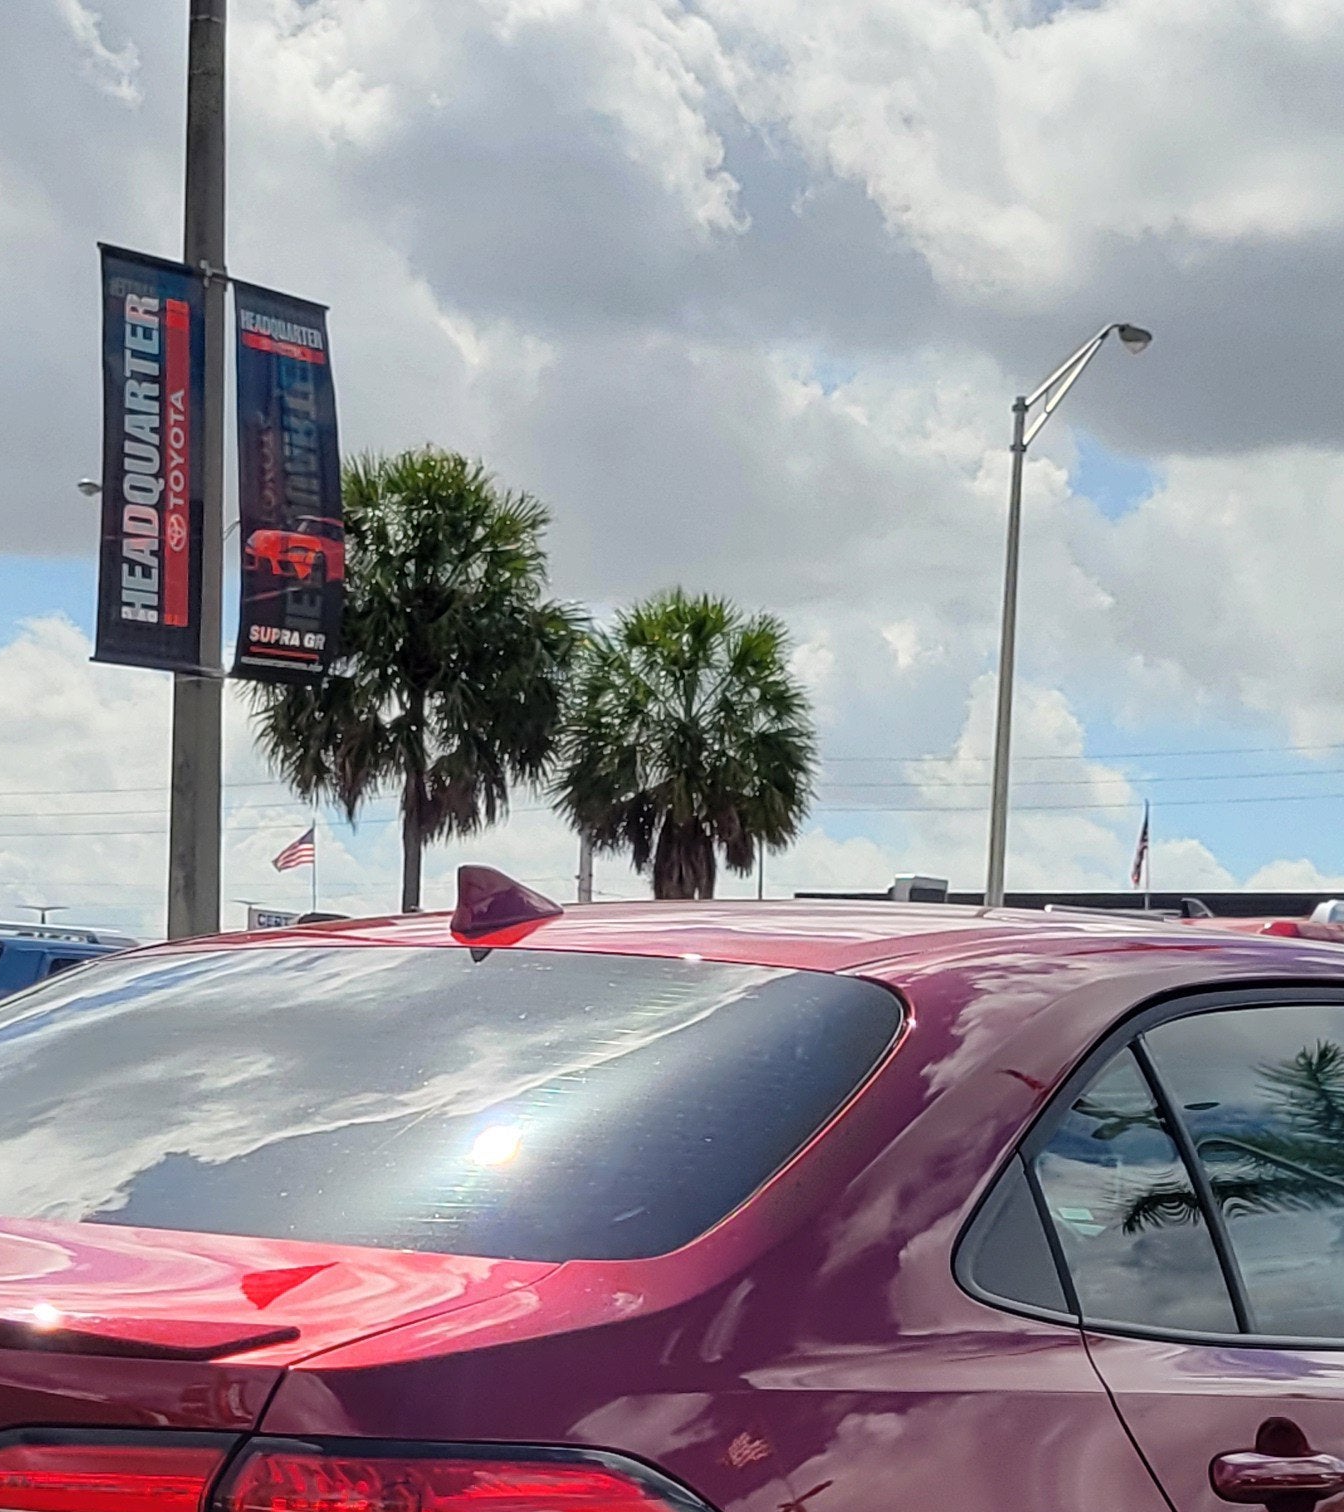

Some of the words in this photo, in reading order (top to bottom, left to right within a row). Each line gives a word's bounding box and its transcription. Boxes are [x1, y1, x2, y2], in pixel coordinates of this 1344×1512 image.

[240, 308, 324, 350] HEADQUARTER
[121, 293, 165, 624] HEADQUARTER
[168, 388, 186, 510] TOYOTA
[249, 624, 301, 647] SUPRA
[303, 632, 326, 650] GR
[258, 913, 294, 927] CERT
